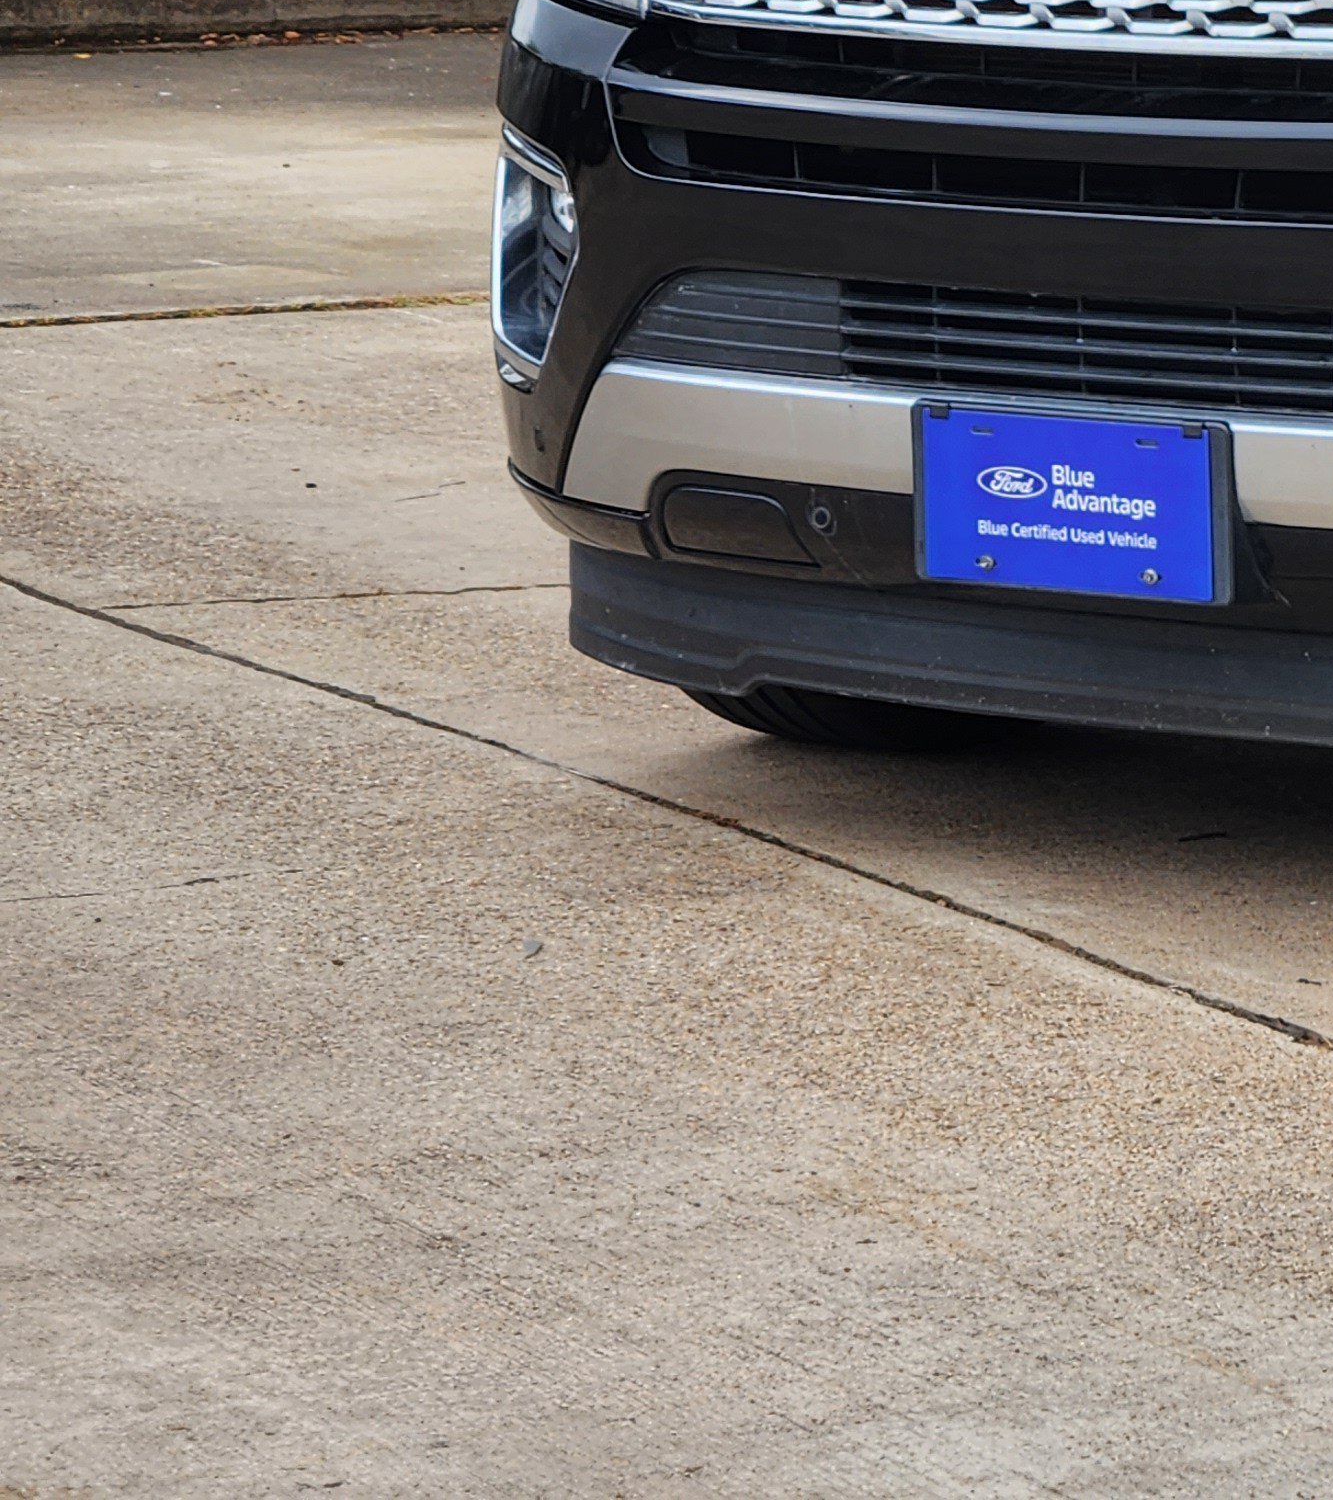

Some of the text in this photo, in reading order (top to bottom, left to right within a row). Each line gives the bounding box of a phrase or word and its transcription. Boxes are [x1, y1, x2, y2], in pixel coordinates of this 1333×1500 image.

[989, 469, 1035, 494] Ford
[1052, 465, 1095, 489] Blue
[1052, 489, 1156, 520] Advantage
[977, 519, 1158, 549] Blue Certified Used Vehicle
